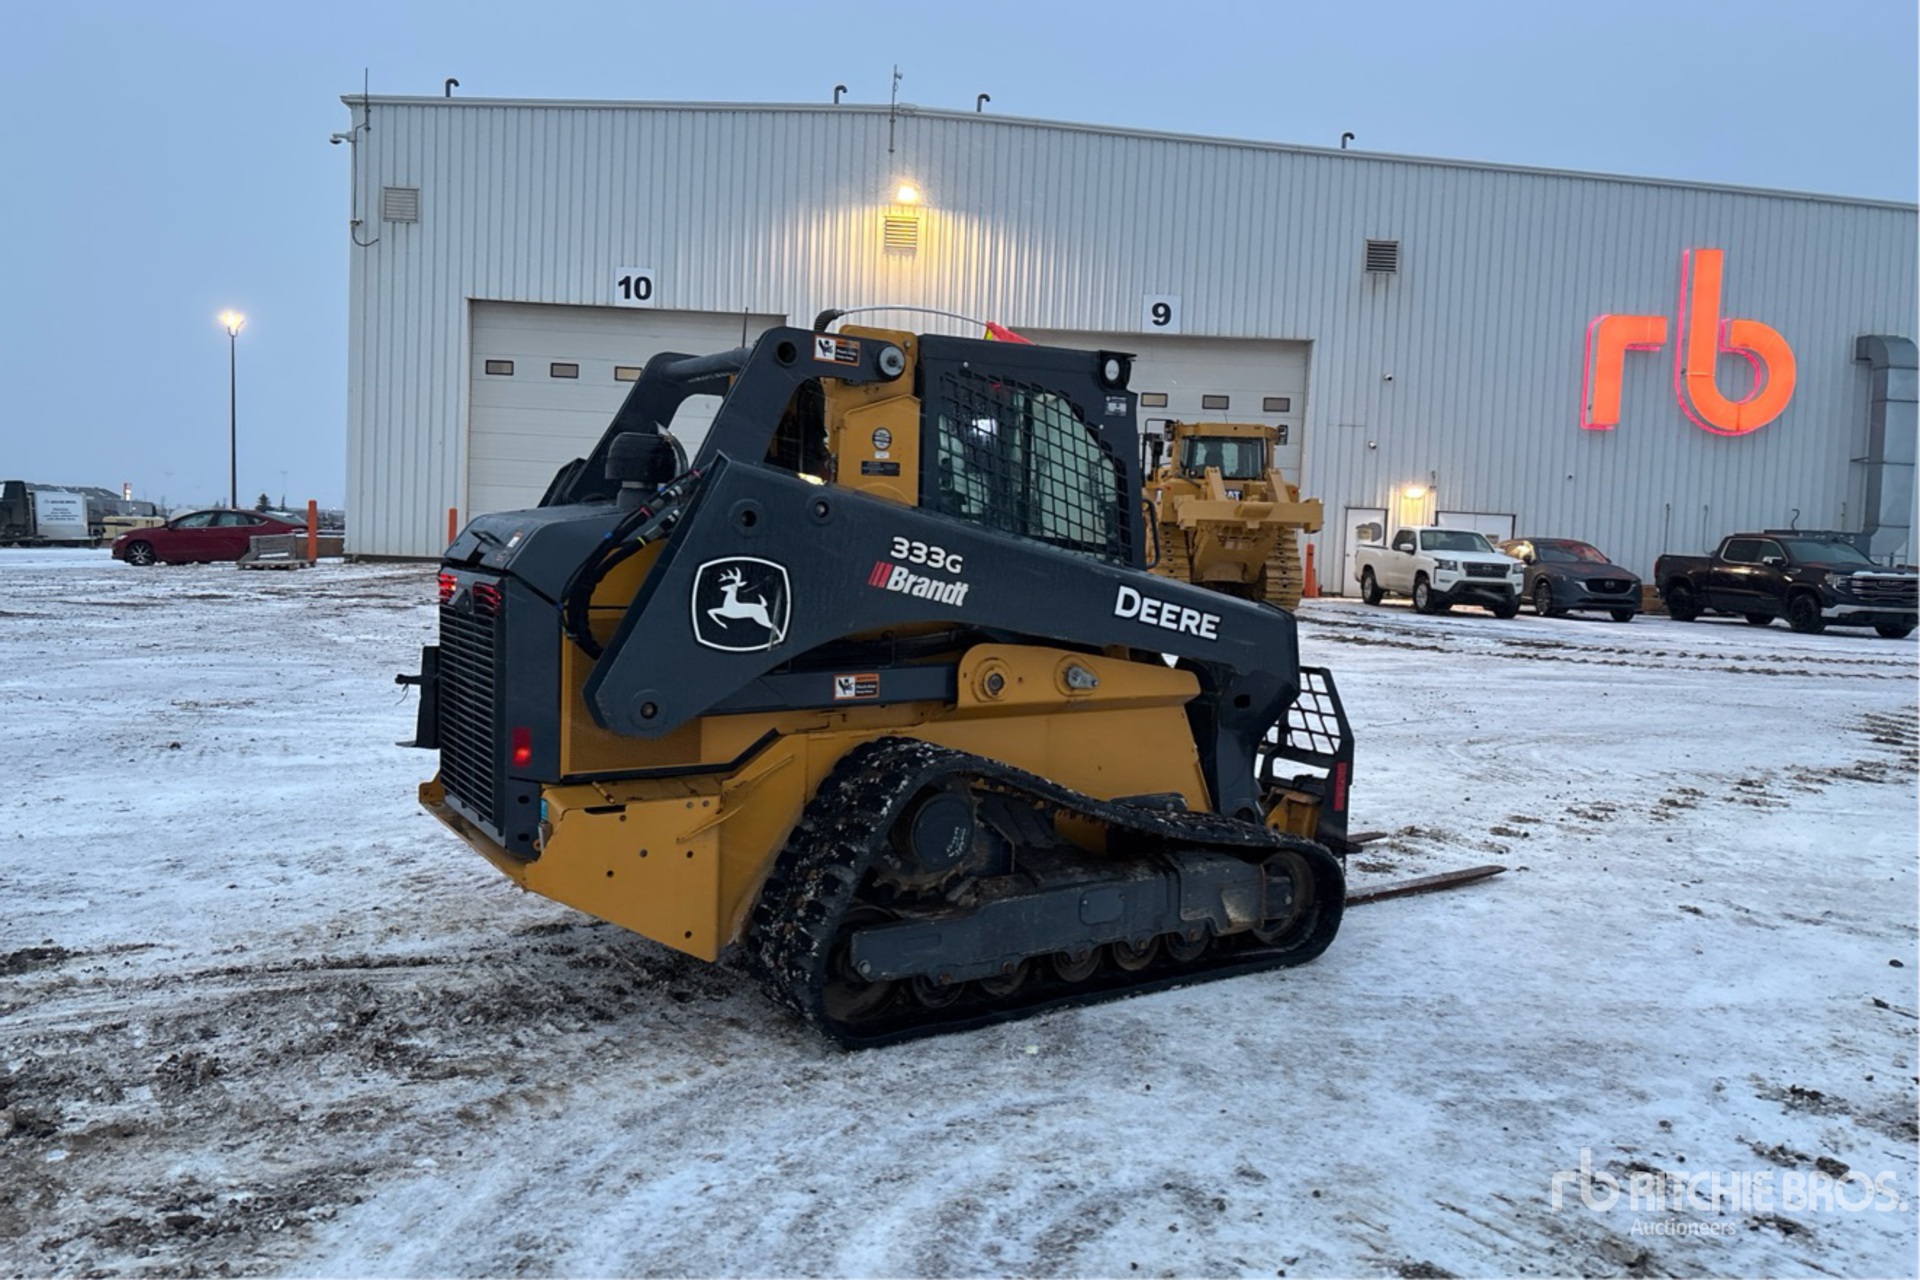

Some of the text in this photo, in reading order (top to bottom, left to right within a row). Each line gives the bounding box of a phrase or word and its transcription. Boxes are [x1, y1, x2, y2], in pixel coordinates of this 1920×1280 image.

[618, 275, 652, 300] 10
[1151, 302, 1171, 326] 9
[1581, 248, 1797, 436] rb
[890, 536, 963, 574] 333G
[886, 565, 969, 607] Brandt
[1114, 585, 1220, 640] DEERE
